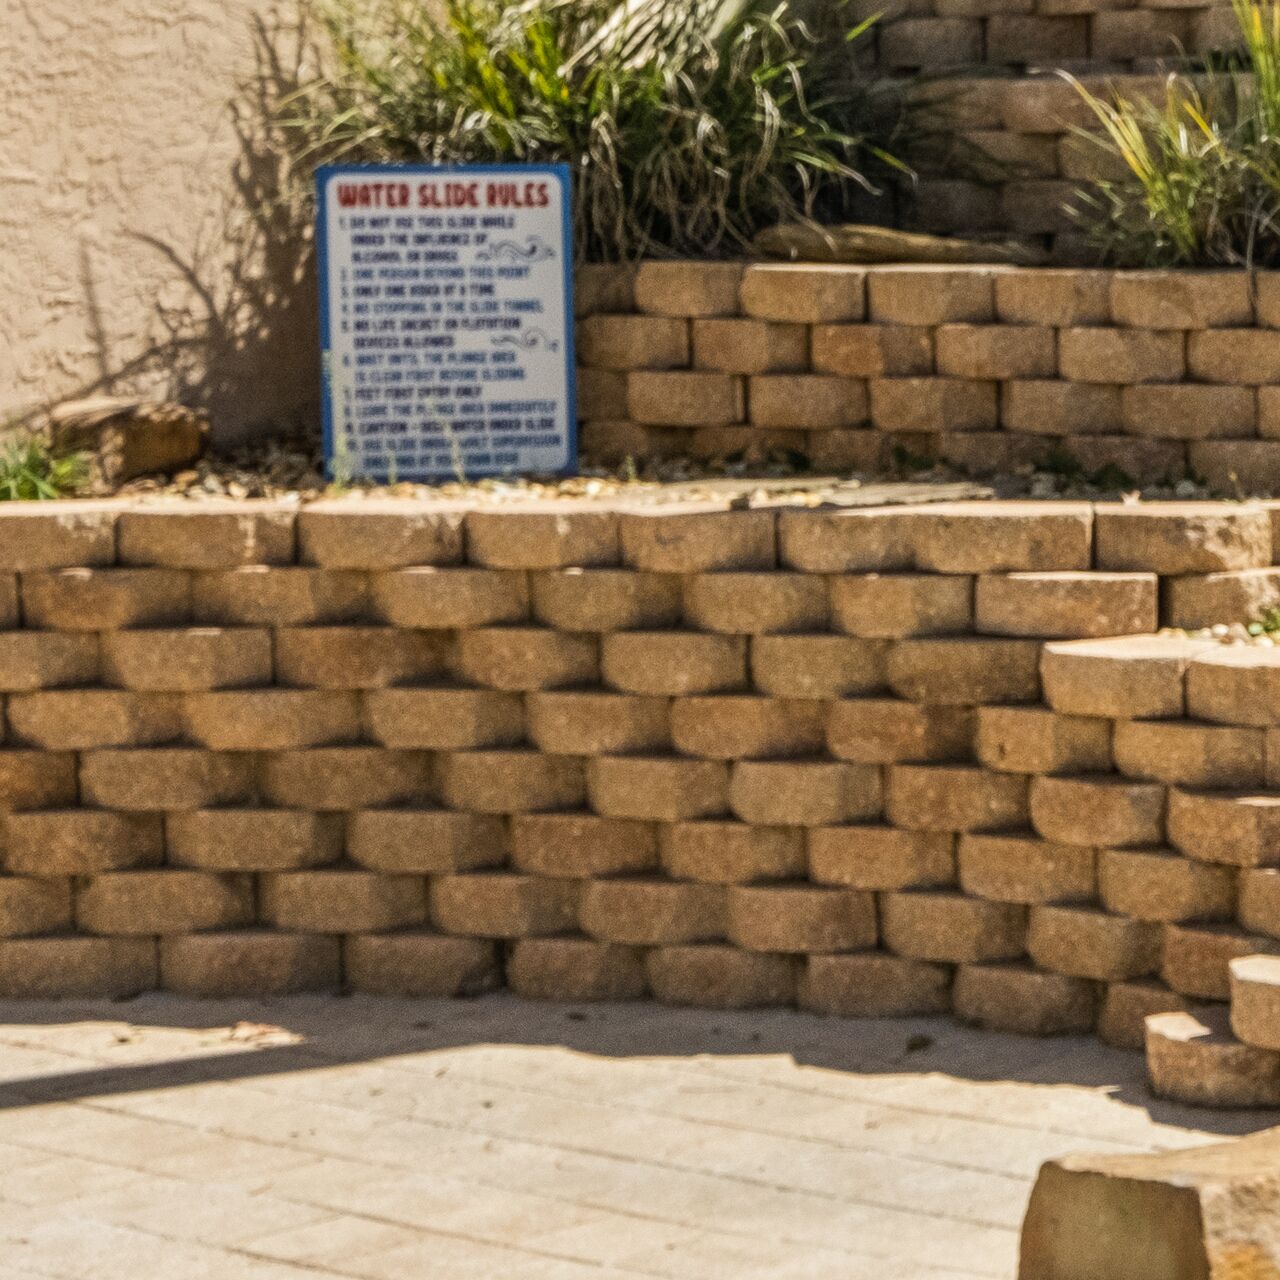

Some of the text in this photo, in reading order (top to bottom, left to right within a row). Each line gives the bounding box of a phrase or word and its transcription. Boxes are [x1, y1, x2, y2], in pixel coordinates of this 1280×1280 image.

[337, 182, 549, 208] WATER SLIDE RULES
